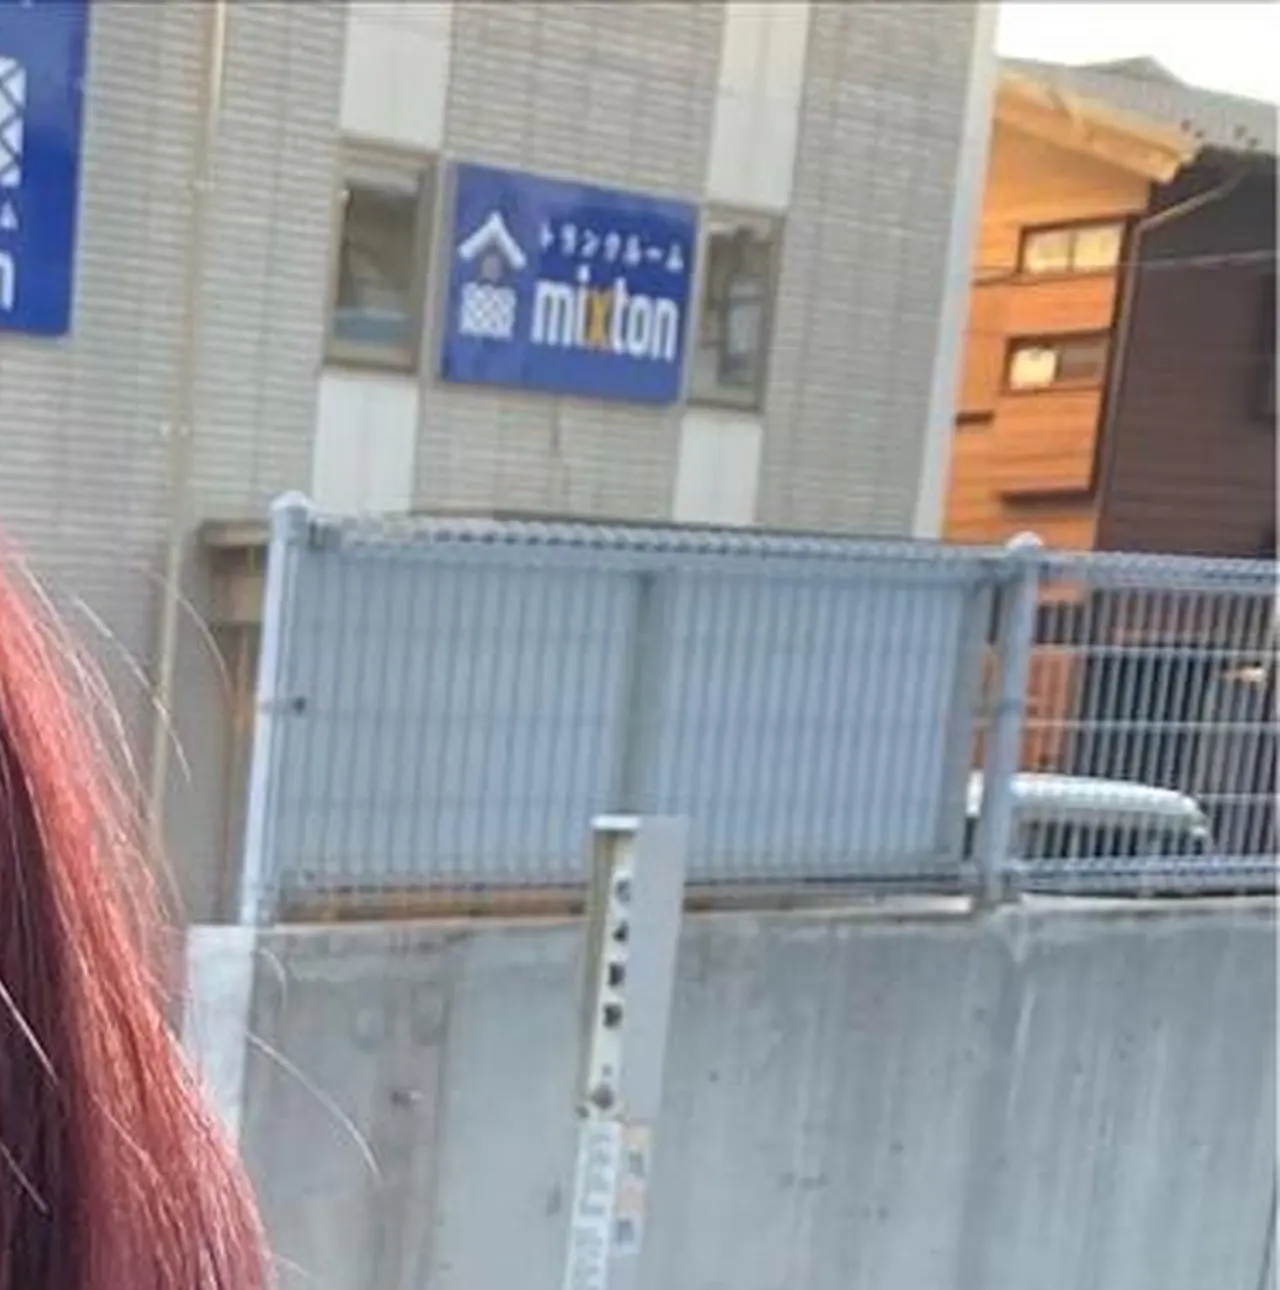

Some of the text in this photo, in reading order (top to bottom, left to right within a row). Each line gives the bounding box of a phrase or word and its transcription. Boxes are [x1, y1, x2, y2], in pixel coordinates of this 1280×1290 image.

[540, 222, 684, 274] トランクルーム
[531, 264, 680, 362] mixton
